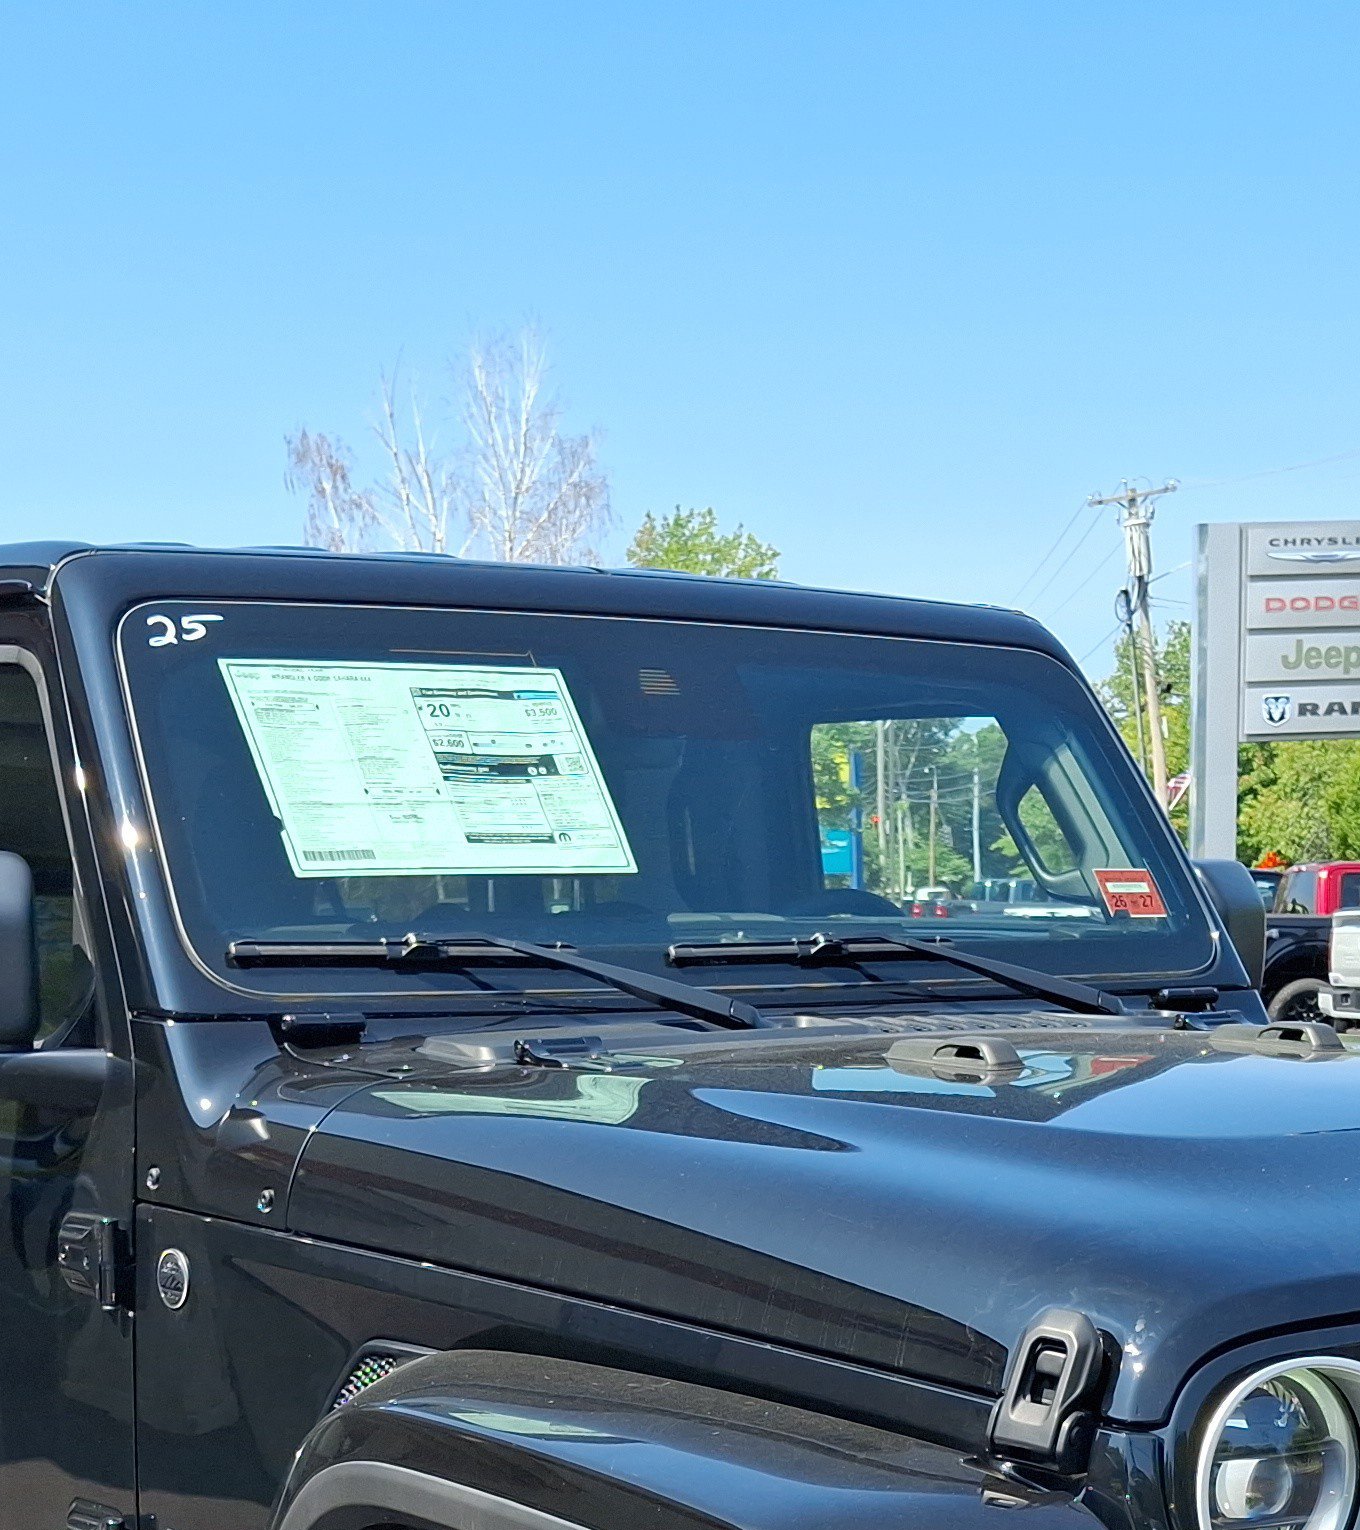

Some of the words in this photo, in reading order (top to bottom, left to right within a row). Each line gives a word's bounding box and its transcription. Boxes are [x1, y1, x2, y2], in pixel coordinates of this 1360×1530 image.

[147, 614, 224, 647] 25
[426, 703, 451, 718] 20
[1111, 894, 1127, 908] 26
[1139, 894, 1154, 908] 27
